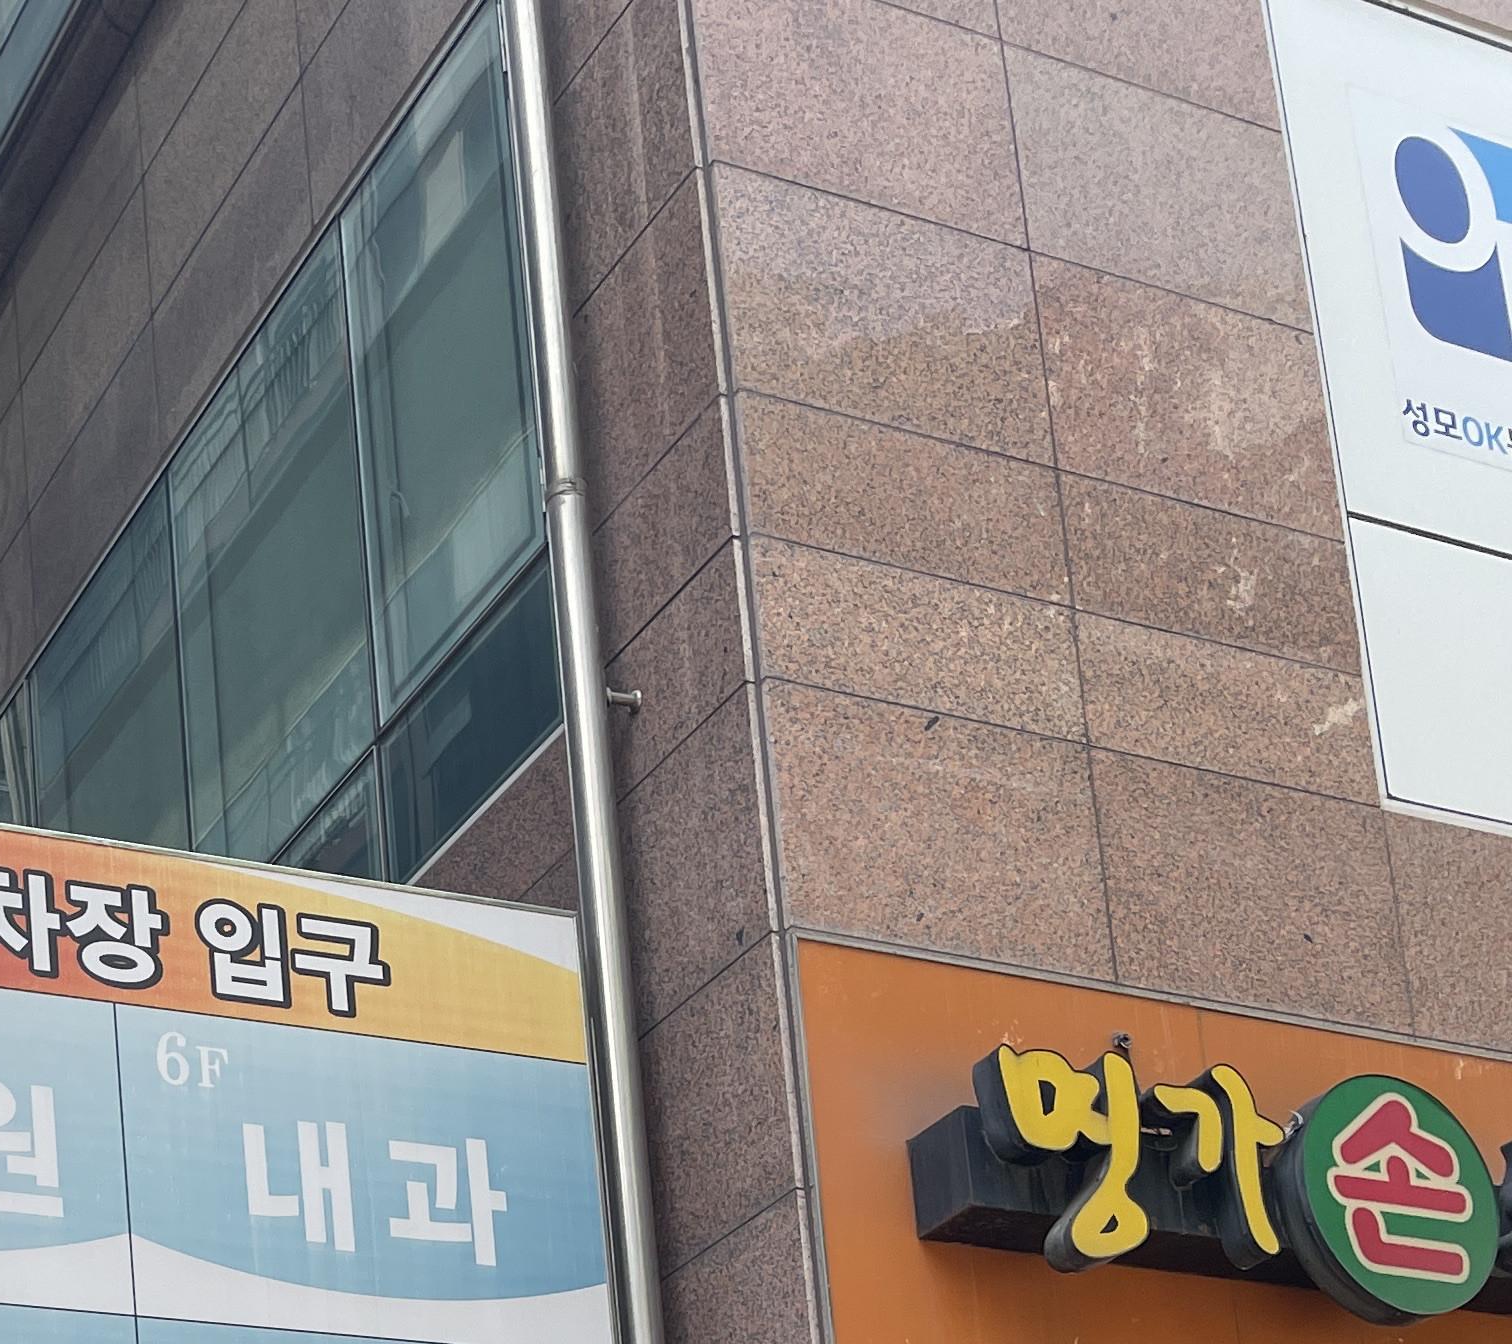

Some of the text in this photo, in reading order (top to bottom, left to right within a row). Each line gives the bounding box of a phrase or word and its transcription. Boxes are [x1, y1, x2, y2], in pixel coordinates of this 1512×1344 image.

[1403, 399, 1512, 454] 성모OK
[195, 897, 389, 1017] 입구
[155, 1030, 228, 1089] 6F
[244, 1119, 508, 1267] 내과
[1329, 1093, 1473, 1284] 손
